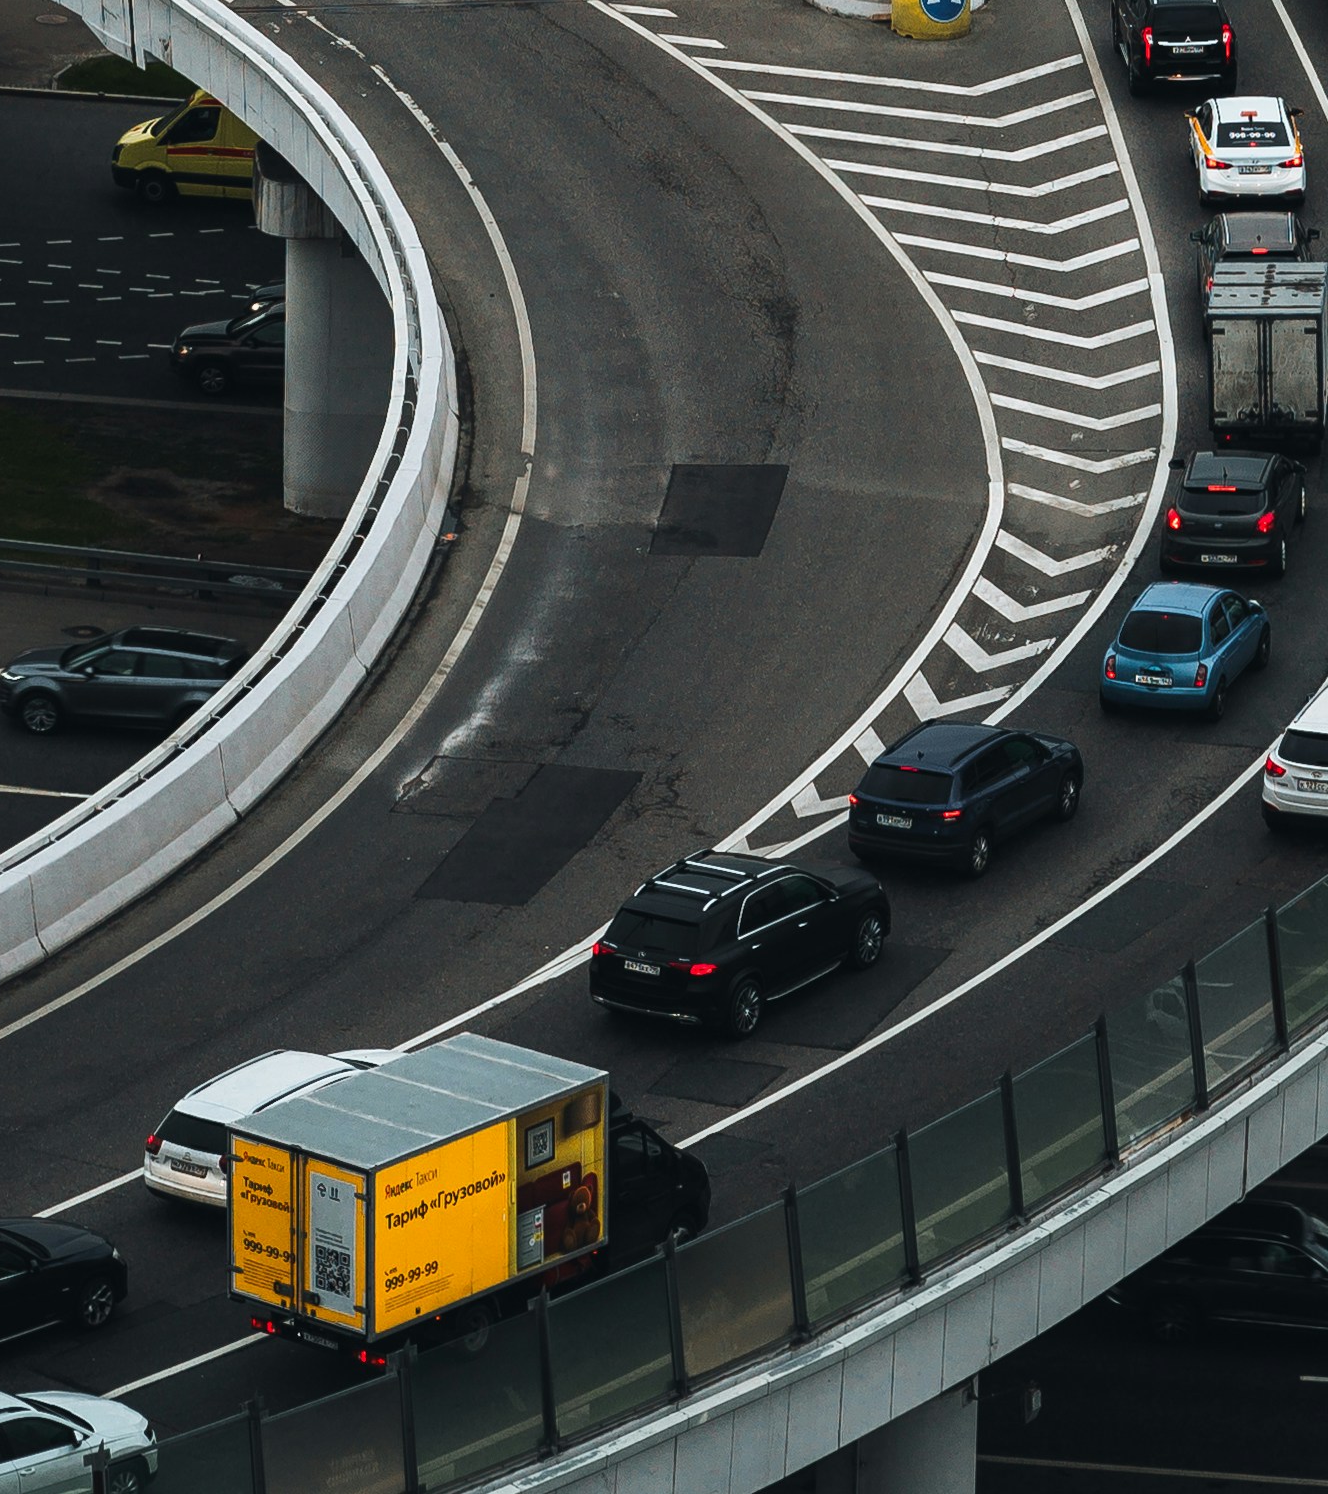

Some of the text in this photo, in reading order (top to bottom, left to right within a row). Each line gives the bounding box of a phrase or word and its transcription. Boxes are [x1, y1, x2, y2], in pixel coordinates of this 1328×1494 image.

[242, 1176, 273, 1196] Тариф
[385, 1168, 437, 1200] Яндекс Такси
[385, 1170, 506, 1229] Тариф «Грузовой»
[385, 1260, 439, 1293] 999-99-99
